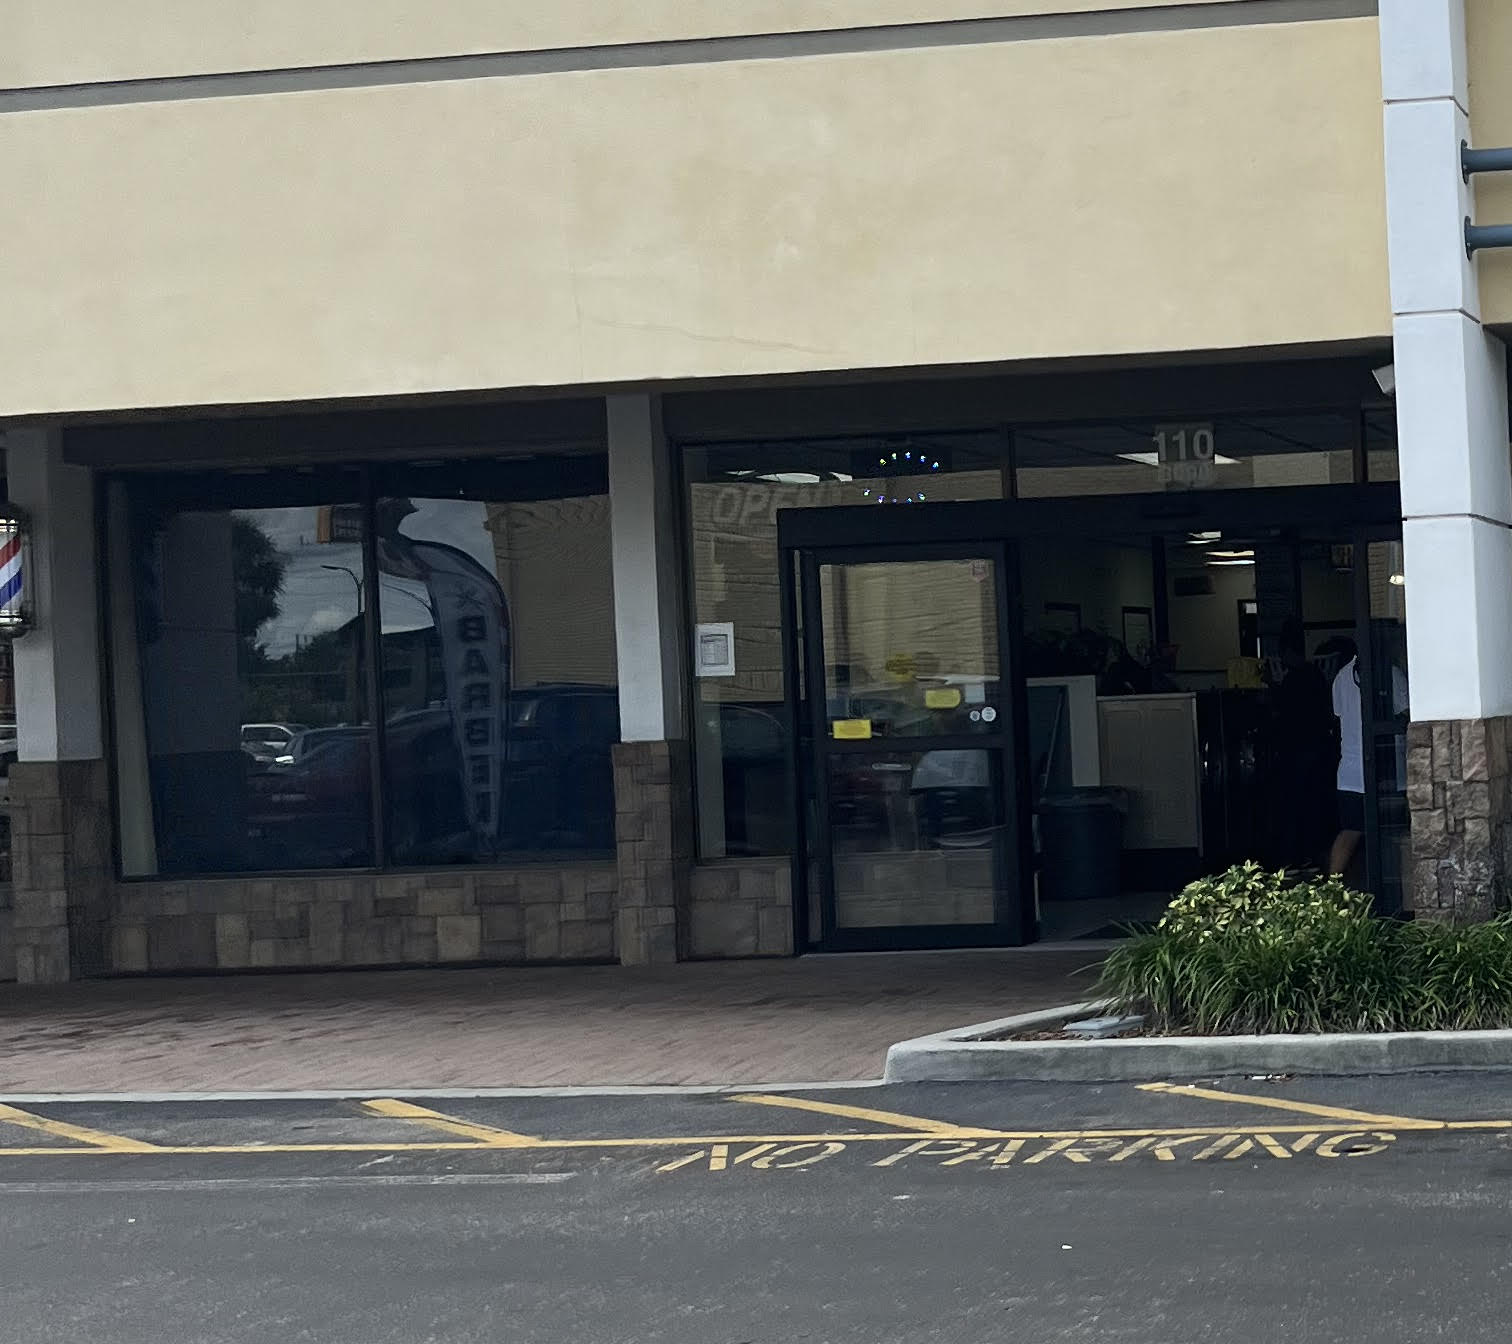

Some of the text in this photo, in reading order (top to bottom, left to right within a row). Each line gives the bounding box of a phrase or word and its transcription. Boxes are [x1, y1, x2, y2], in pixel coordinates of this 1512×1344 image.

[1152, 428, 1214, 461] 110
[656, 1142, 846, 1173] NO
[873, 1131, 1396, 1167] PARKING
